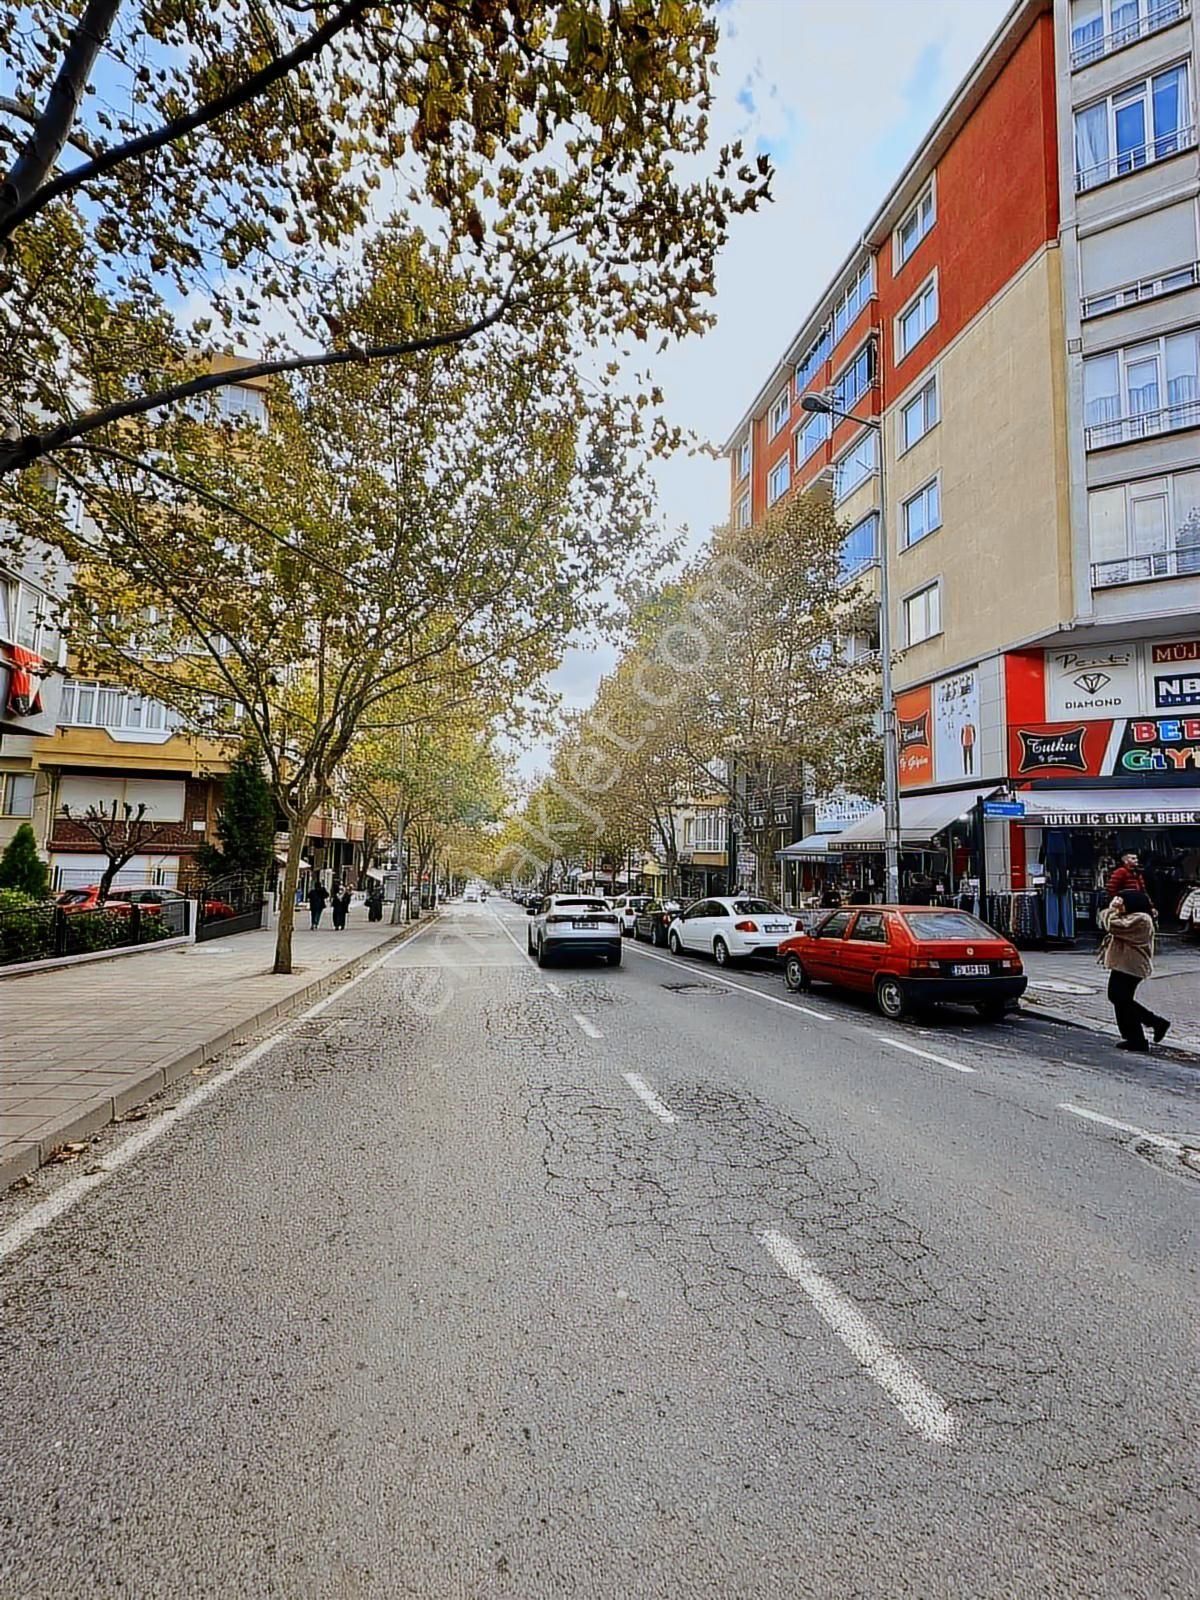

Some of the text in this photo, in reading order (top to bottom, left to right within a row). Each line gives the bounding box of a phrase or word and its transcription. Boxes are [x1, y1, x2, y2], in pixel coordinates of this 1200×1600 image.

[1065, 697, 1122, 709] DIAMOND
[1027, 737, 1077, 753] Tutku
[1043, 814, 1081, 825] TUTKU
[1157, 812, 1196, 823] BEBEK
